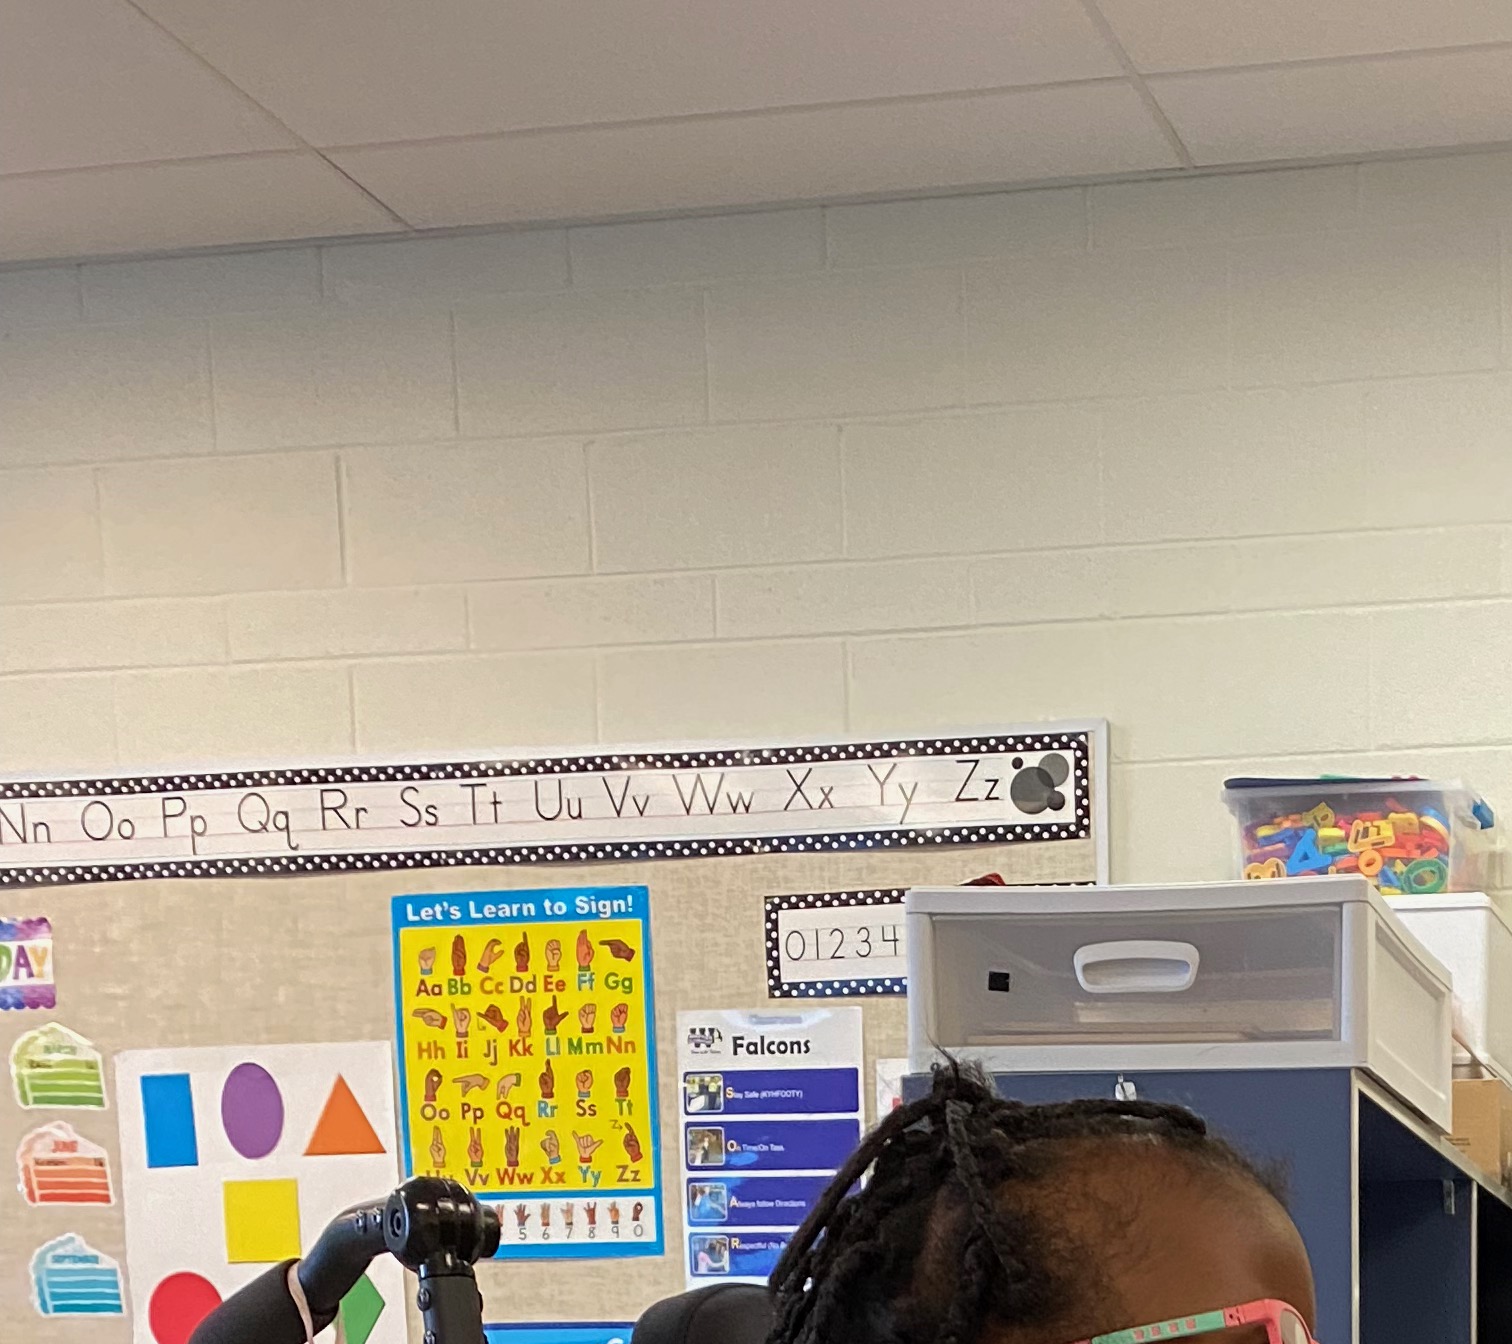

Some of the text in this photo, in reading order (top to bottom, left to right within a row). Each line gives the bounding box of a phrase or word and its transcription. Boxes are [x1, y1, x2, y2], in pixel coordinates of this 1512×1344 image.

[81, 800, 136, 841] Oo
[161, 797, 207, 855] Pp
[237, 792, 299, 851] Qq
[320, 789, 368, 831] Rr
[400, 786, 439, 828] Ss
[460, 783, 502, 826] Tt
[534, 779, 583, 821] Uu
[602, 775, 649, 818] Vv
[672, 772, 754, 815] Ww
[783, 767, 834, 811] Xx
[867, 763, 919, 825] Yy
[954, 760, 1000, 802] Zz
[406, 895, 633, 923] Let's Learn to Sign!
[416, 972, 633, 997] Aa Bb Cc Dd Ee Ff Gg
[417, 1036, 636, 1066] Hh Ii Jj Kk Ll Mm Nn
[732, 1035, 811, 1056] Falcons
[420, 1099, 633, 1127] Oo Pp Qq Rr Ss Tt
[464, 1168, 490, 1187] Vv
[495, 1168, 535, 1186] Ww
[540, 1167, 566, 1185] Xx
[578, 1166, 602, 1187] Yy
[616, 1165, 641, 1183] Zz
[518, 1224, 644, 1240] 5 6 7 8 9 0
